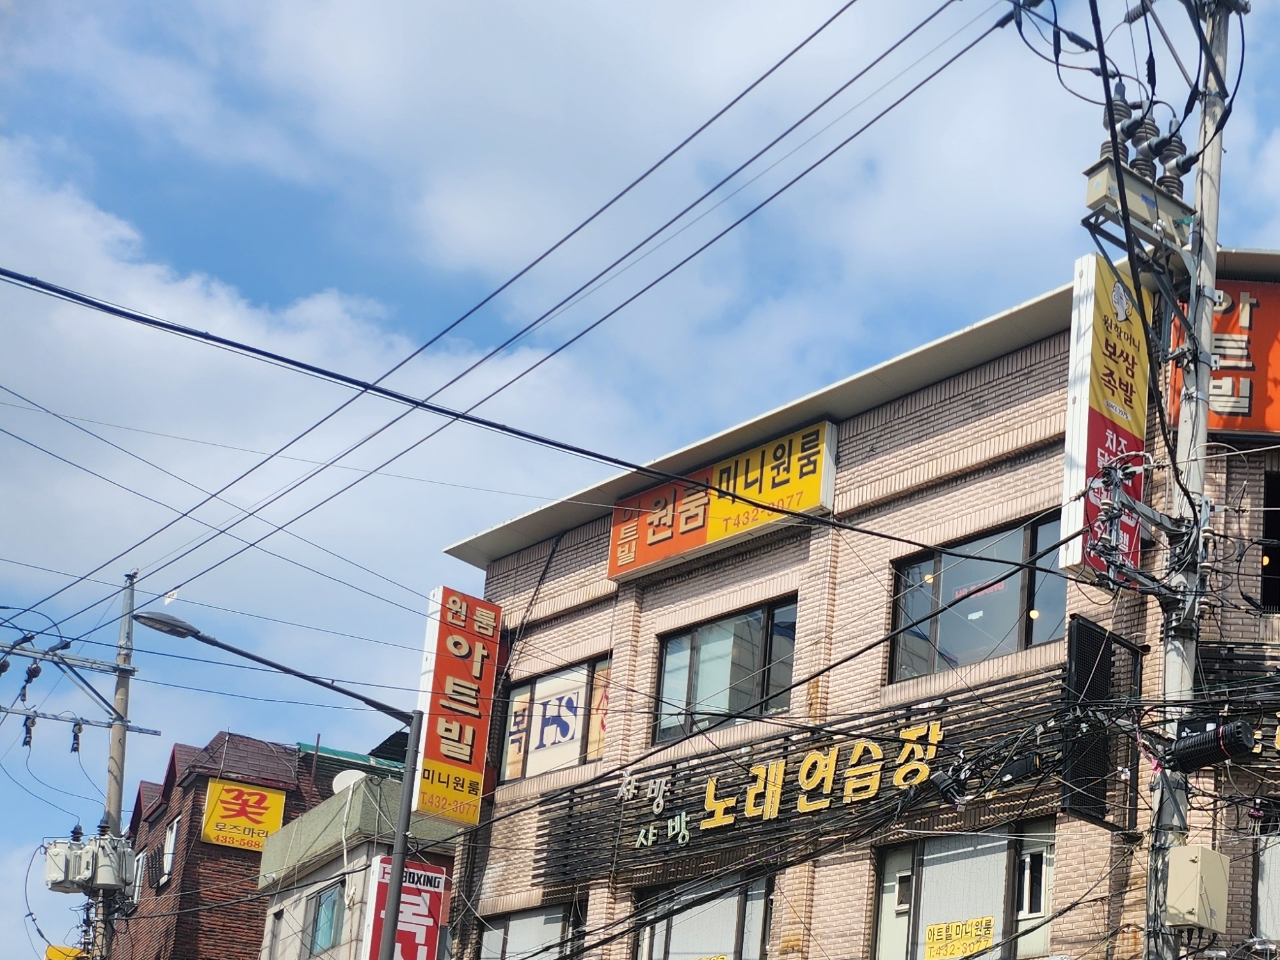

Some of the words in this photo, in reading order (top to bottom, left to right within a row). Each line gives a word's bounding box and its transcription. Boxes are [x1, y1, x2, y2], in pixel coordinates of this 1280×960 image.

[1101, 315, 1142, 352] 원할머니
[1102, 337, 1138, 380] 보쌈
[1100, 365, 1137, 410] 족발
[717, 428, 822, 505] 미니원룸
[646, 476, 711, 546] 원룸
[616, 500, 641, 567] 아트빌
[445, 595, 498, 638] 원룸
[435, 633, 491, 766] 아트빌
[421, 767, 480, 797] 미니원룸
[698, 721, 944, 832] 노래연습장
[219, 788, 271, 826] 꽃
[213, 821, 270, 839] 로즈마리
[213, 834, 264, 850] 433-568
[635, 811, 692, 849] 샤방
